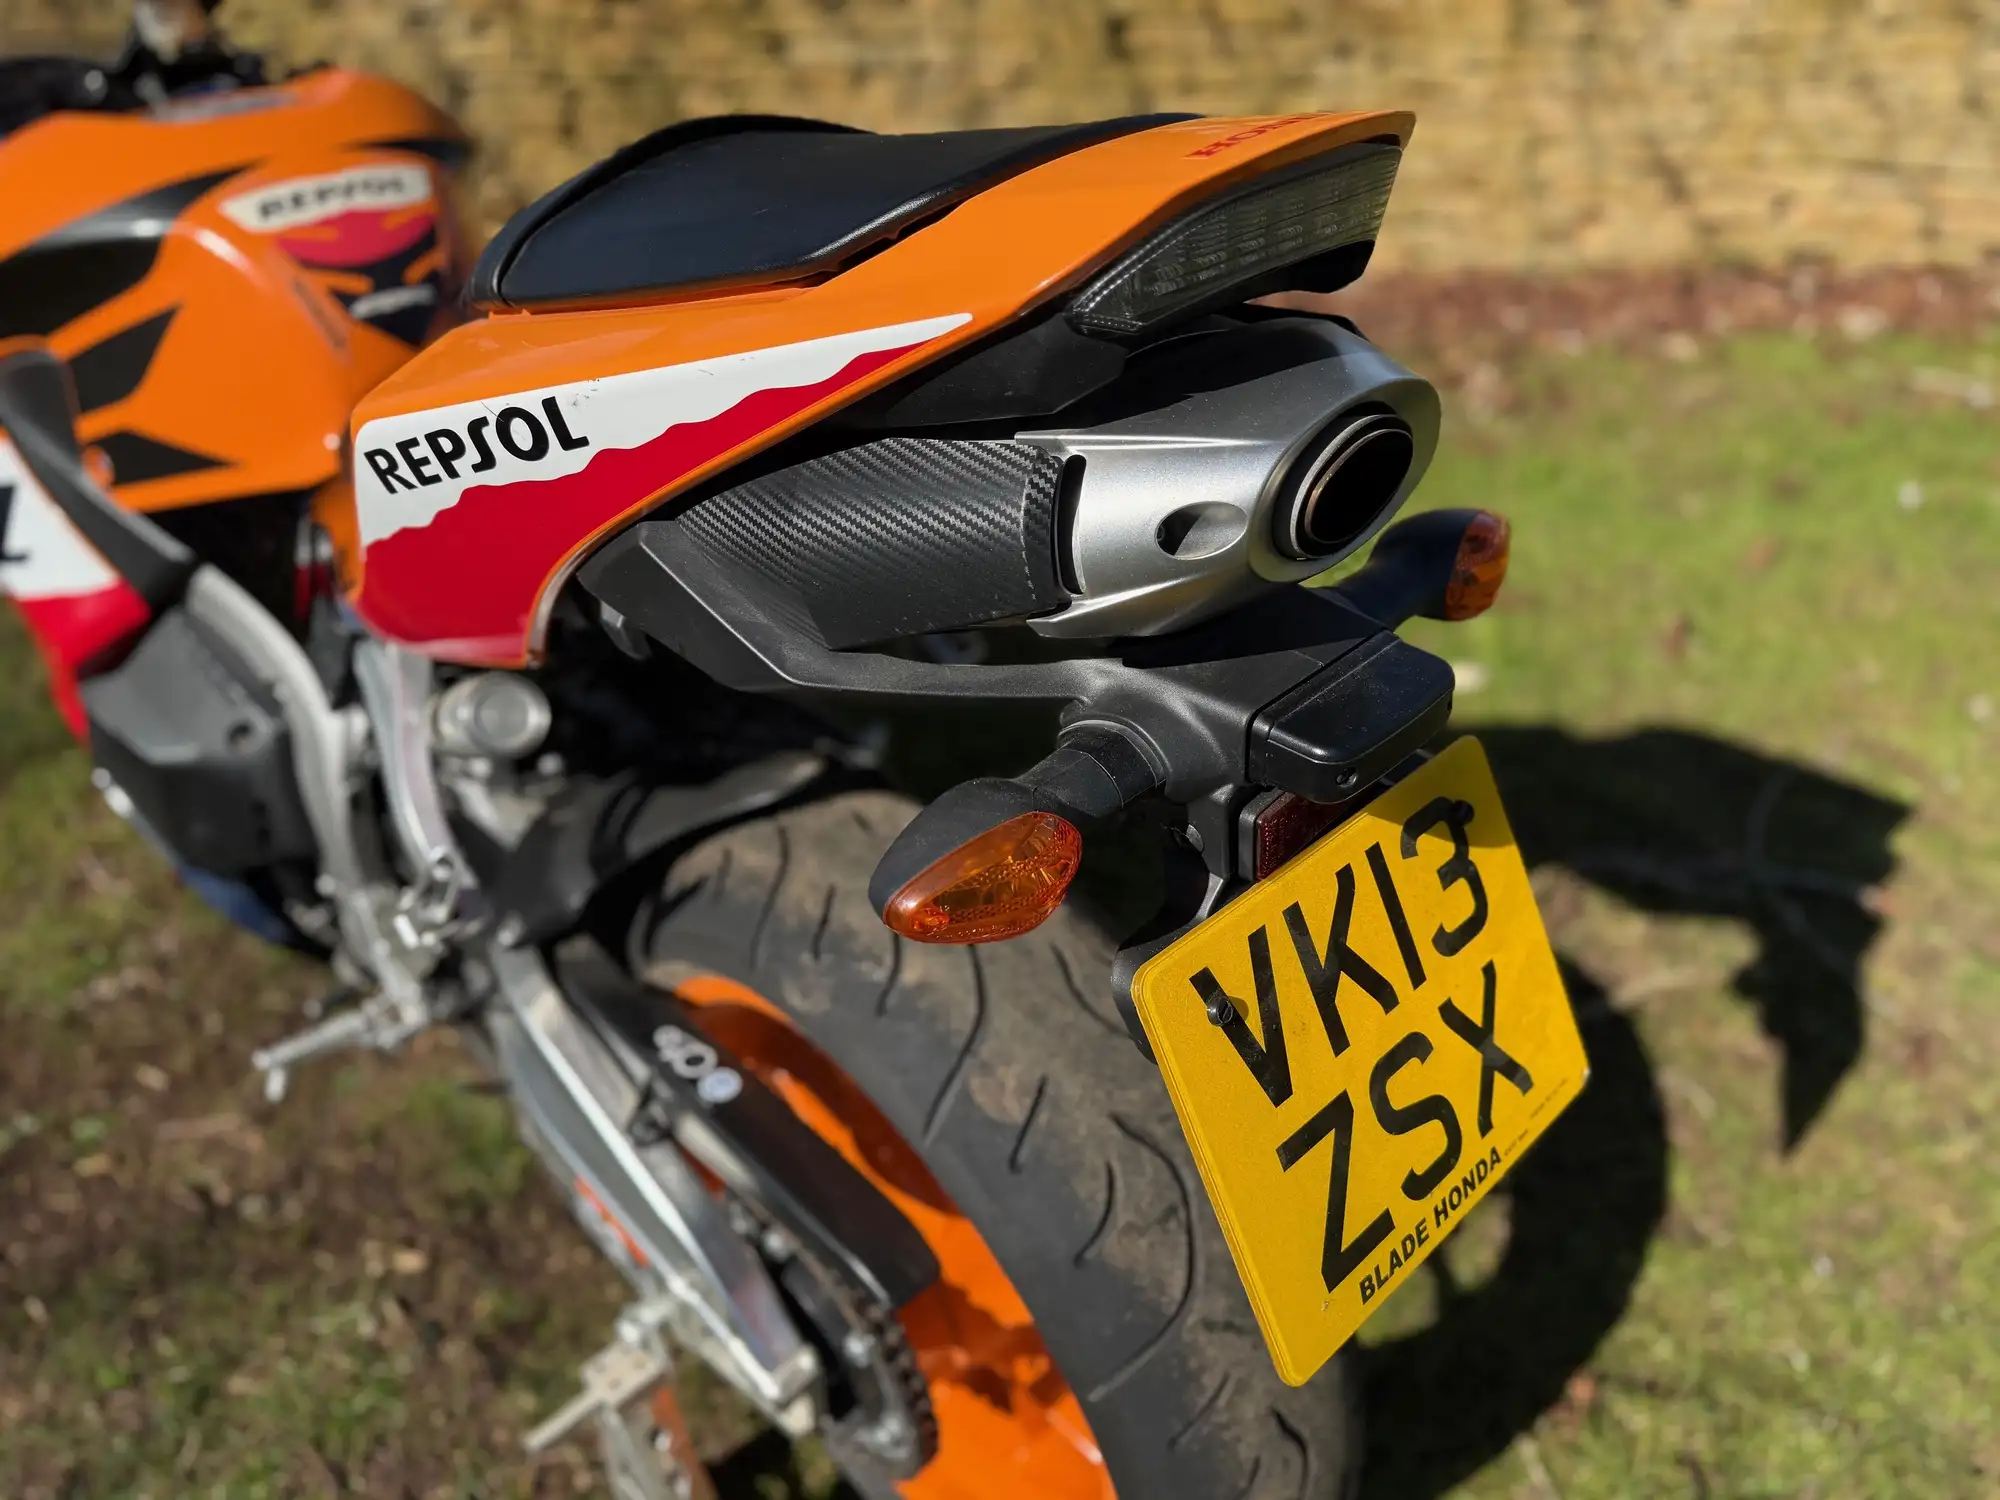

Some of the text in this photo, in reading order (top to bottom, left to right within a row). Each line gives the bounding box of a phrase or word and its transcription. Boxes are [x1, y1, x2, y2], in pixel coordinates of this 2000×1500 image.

[363, 395, 590, 495] REPSOL
[1189, 795, 1489, 1108] VK13
[1275, 959, 1534, 1294] ZSX
[1358, 1146, 1502, 1306] BLADE HONDA
